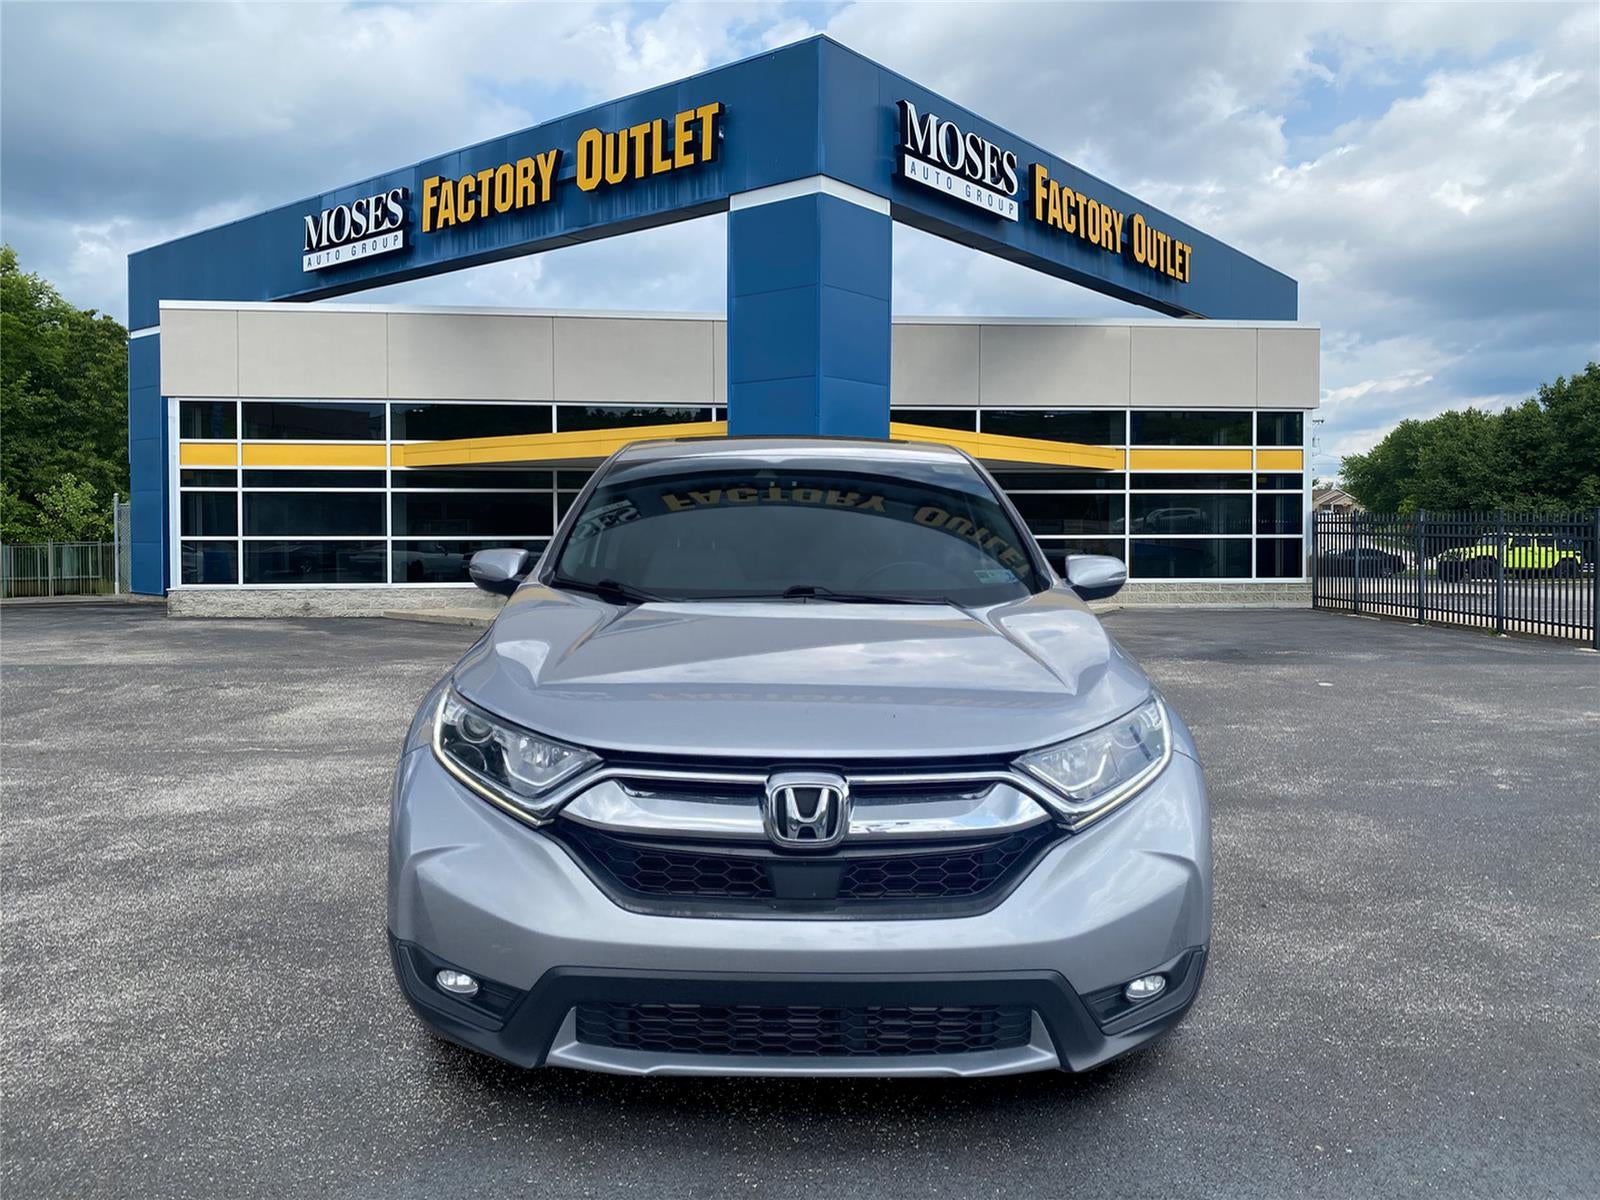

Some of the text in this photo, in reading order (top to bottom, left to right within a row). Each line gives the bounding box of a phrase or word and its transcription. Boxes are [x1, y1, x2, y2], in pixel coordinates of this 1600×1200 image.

[421, 102, 720, 232] FACTORY OUTLET
[904, 100, 1018, 196] MOSES
[910, 161, 1014, 214] AUTO GROUP
[303, 187, 404, 251] MOSES
[307, 235, 399, 267] AUTO GROUP
[1035, 163, 1192, 283] FACTORY OUTLET
